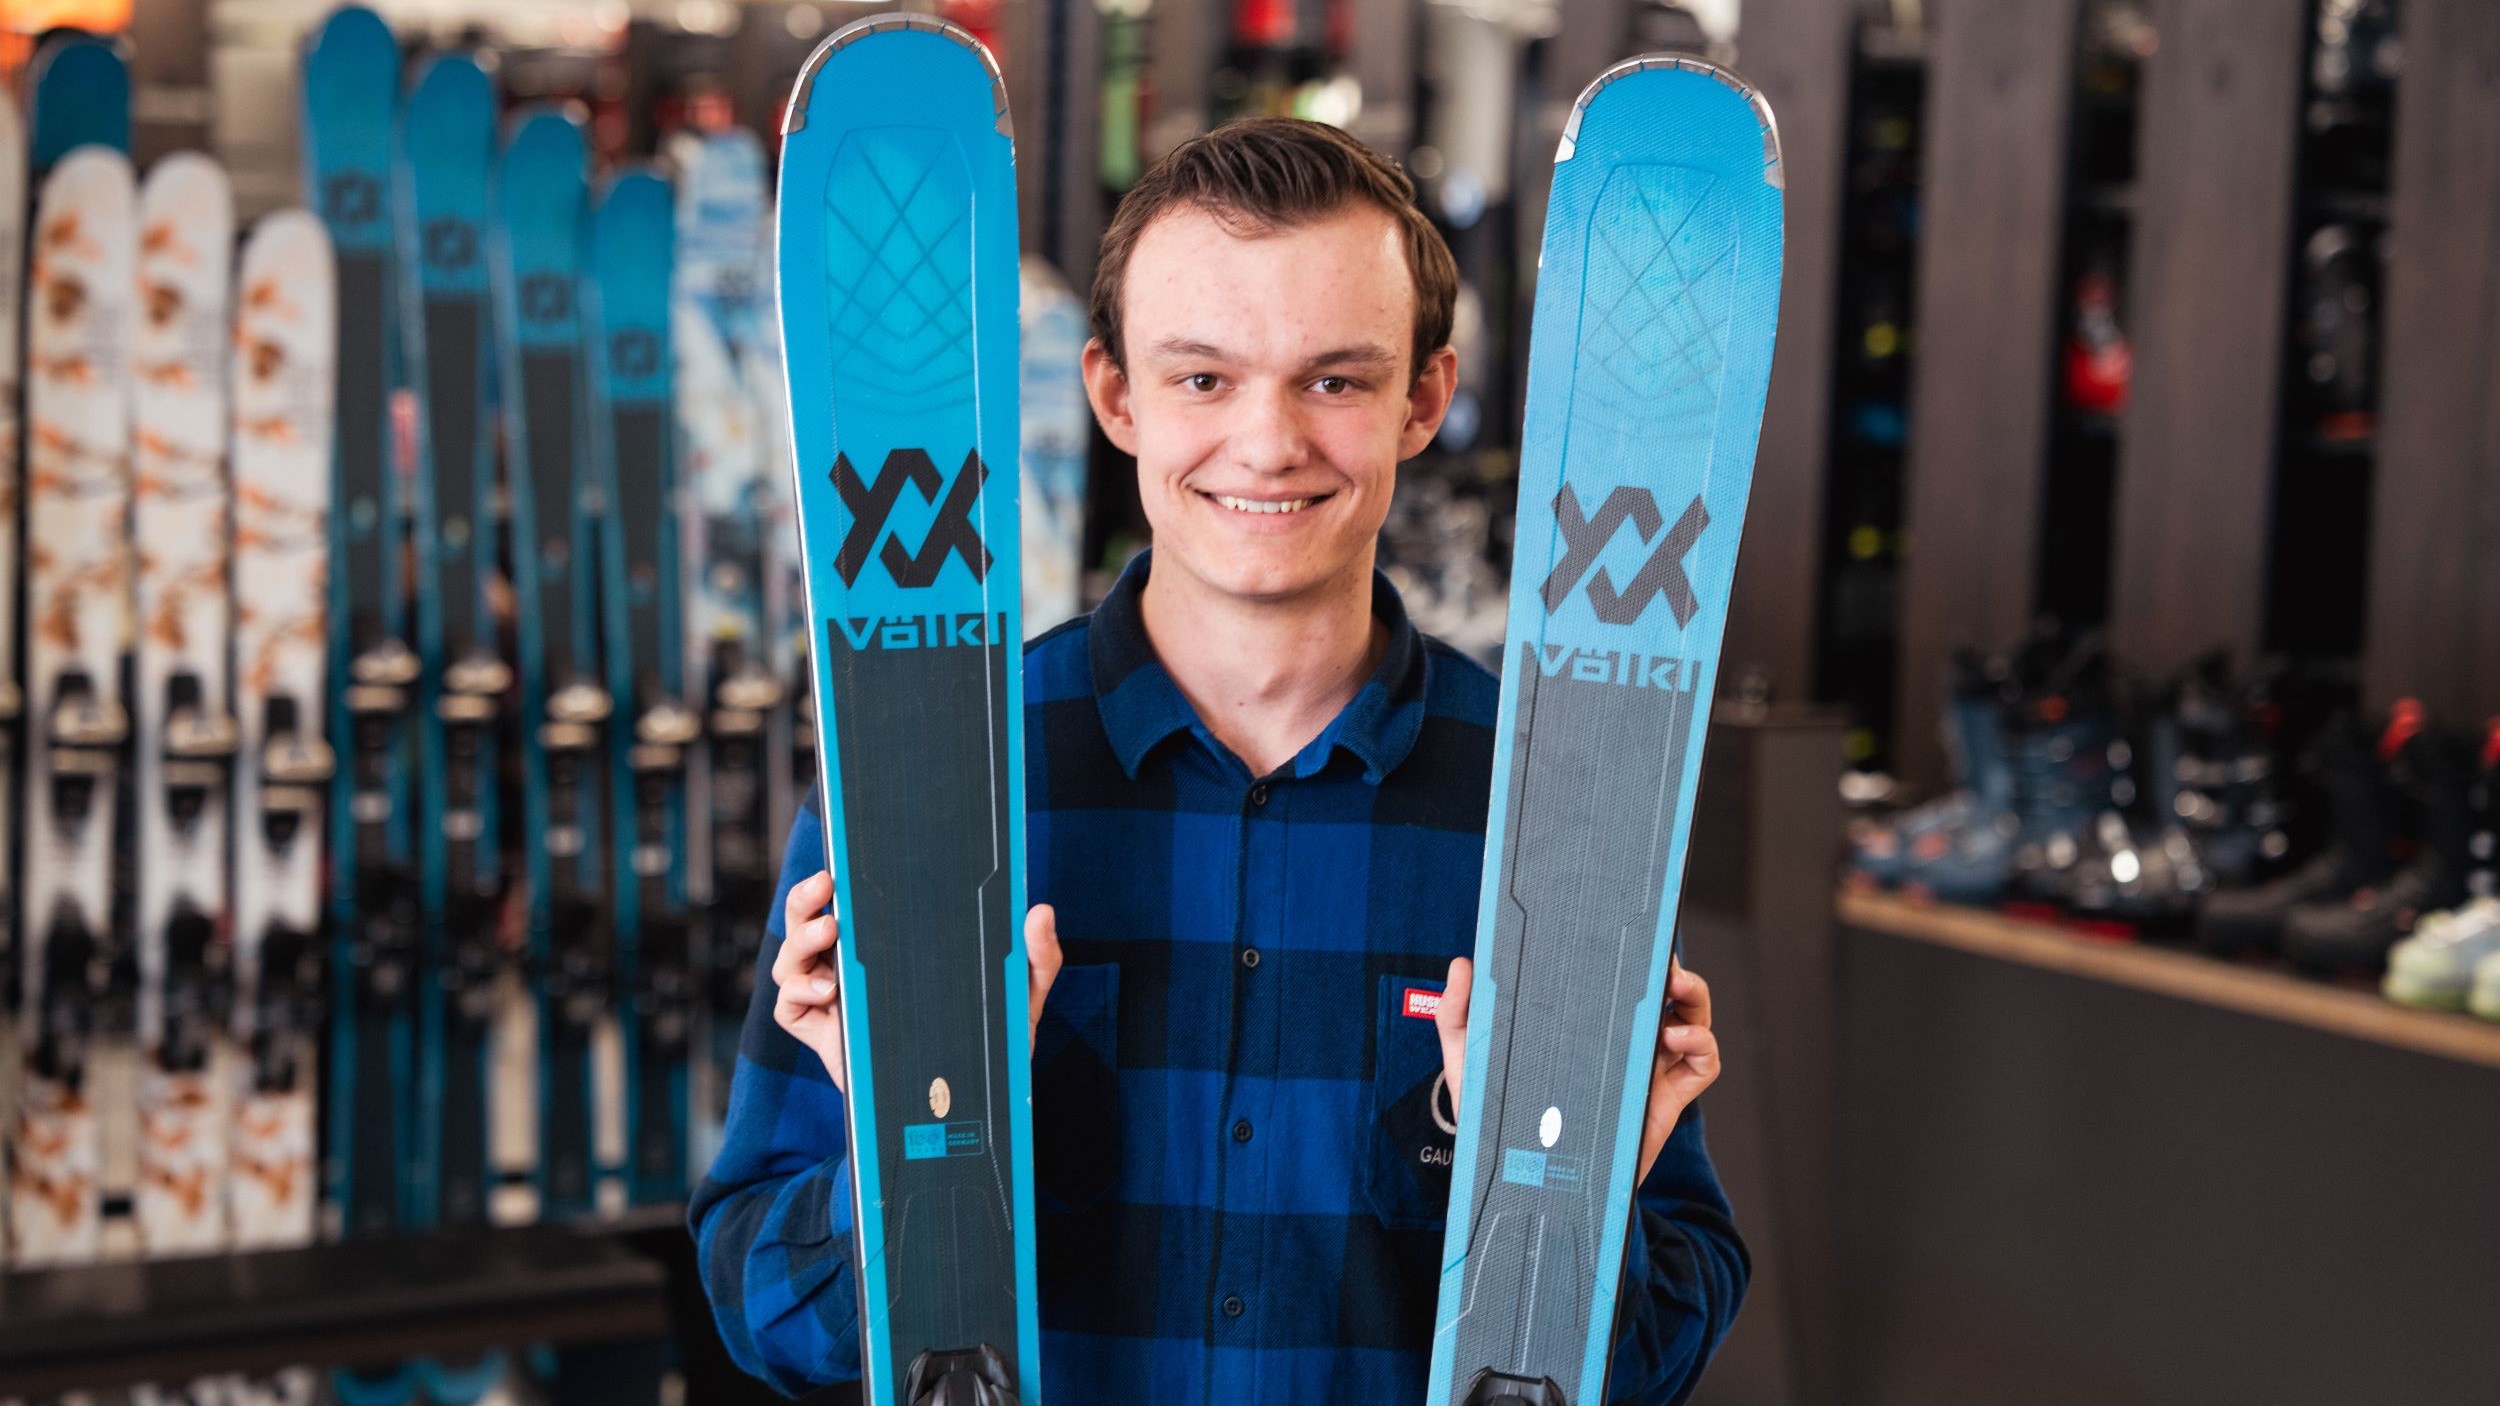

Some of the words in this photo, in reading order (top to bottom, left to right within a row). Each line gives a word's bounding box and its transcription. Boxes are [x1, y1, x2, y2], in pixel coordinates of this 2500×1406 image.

[1409, 993, 1441, 1009] HUSK
[1409, 1005, 1438, 1015] WEA
[1420, 1146, 1452, 1166] GAU
